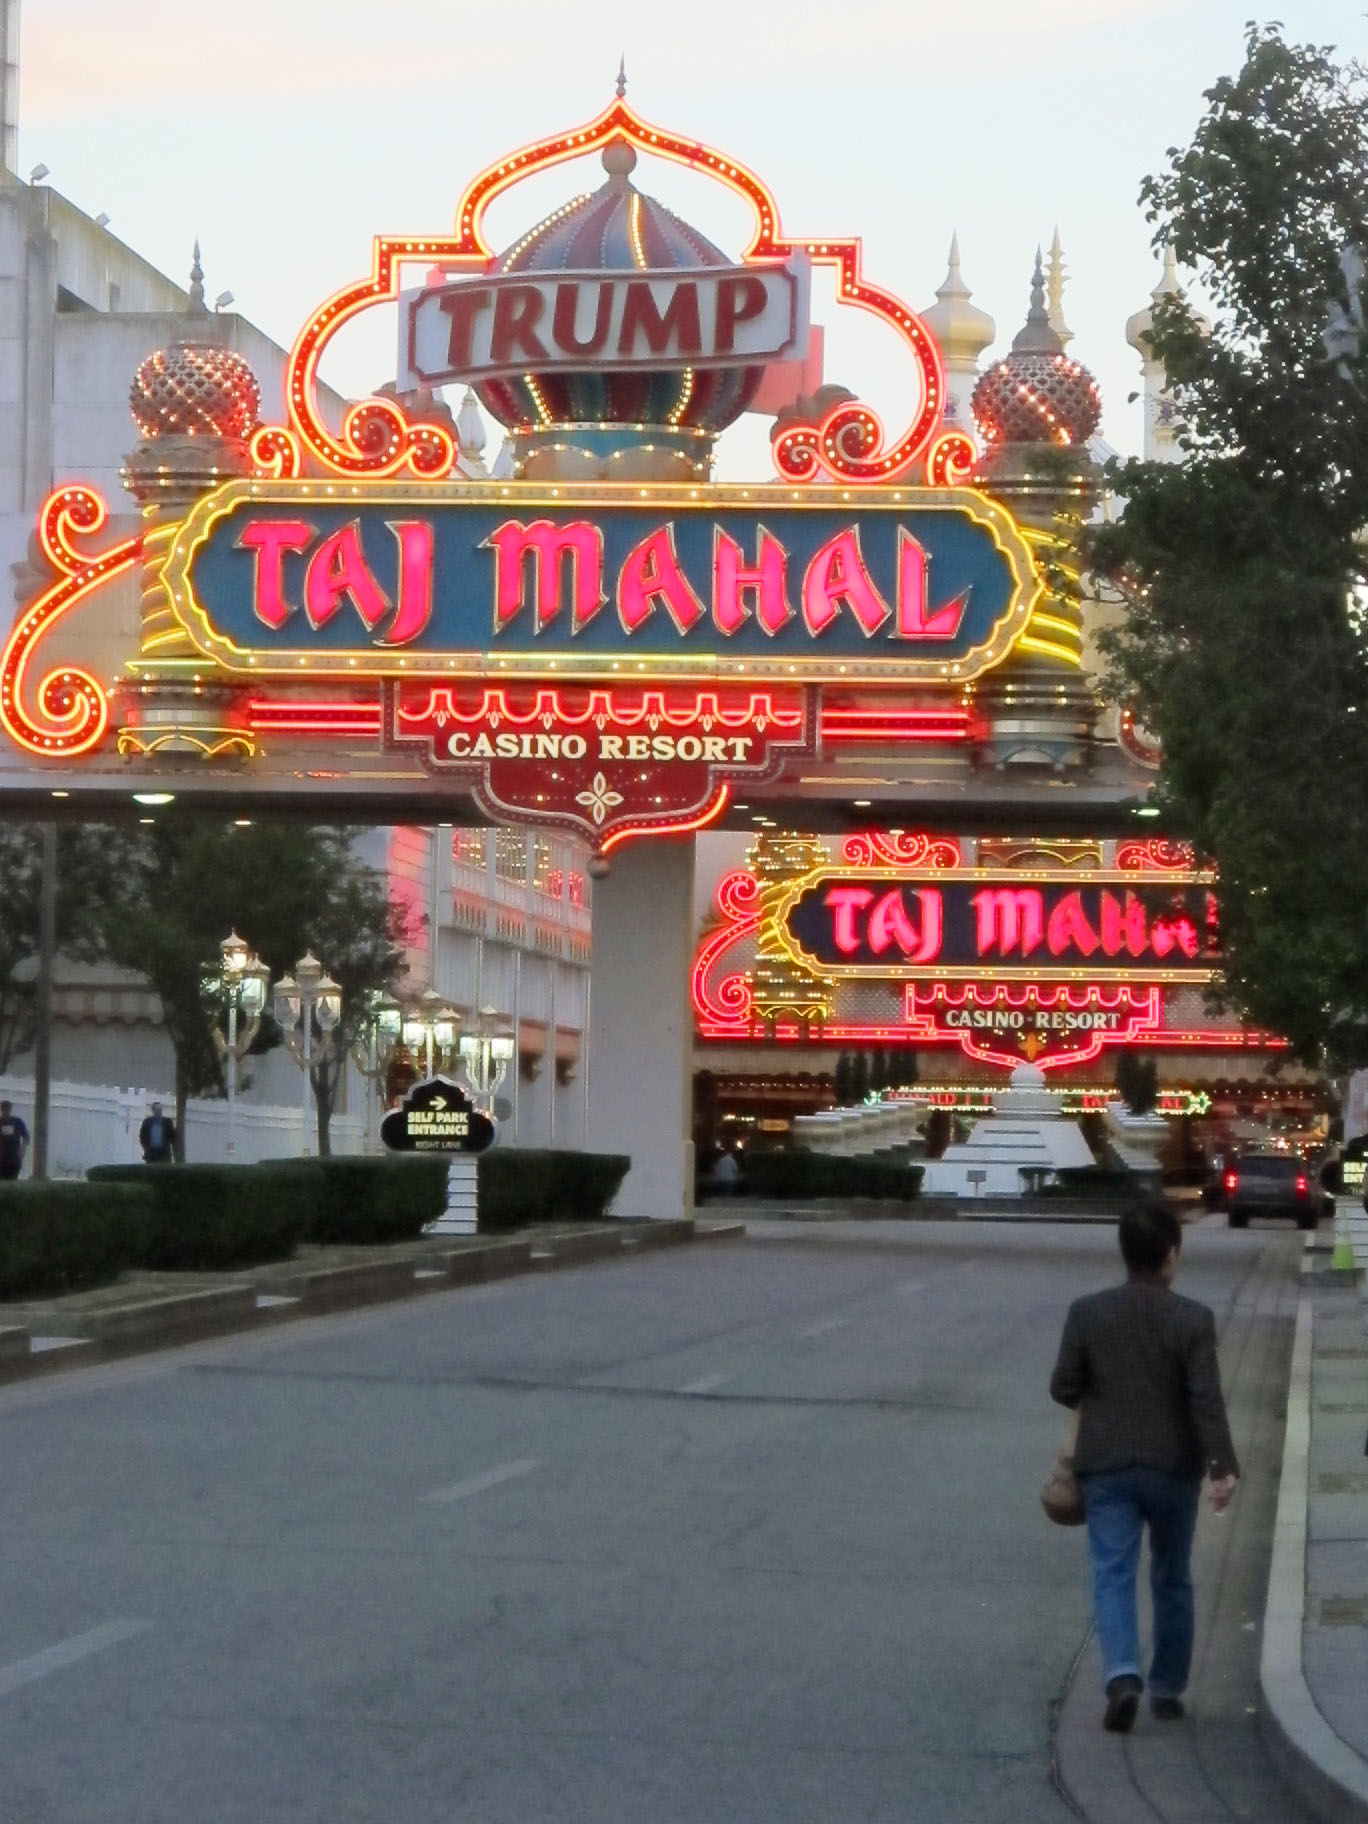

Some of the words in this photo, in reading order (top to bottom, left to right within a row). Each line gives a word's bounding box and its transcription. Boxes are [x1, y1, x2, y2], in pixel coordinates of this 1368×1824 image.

[439, 276, 768, 368] TRUMP
[234, 519, 435, 647] TAJ
[477, 518, 973, 640] MAHAL
[447, 731, 586, 760] CASINO
[599, 734, 753, 763] RESORT
[825, 886, 943, 964] TAJ
[945, 1009, 1024, 1028] CASINO
[1035, 1011, 1120, 1029] RESORT
[408, 1112, 434, 1123] SELF
[436, 1112, 469, 1123] PARK
[408, 1123, 469, 1135] ENTRANCE
